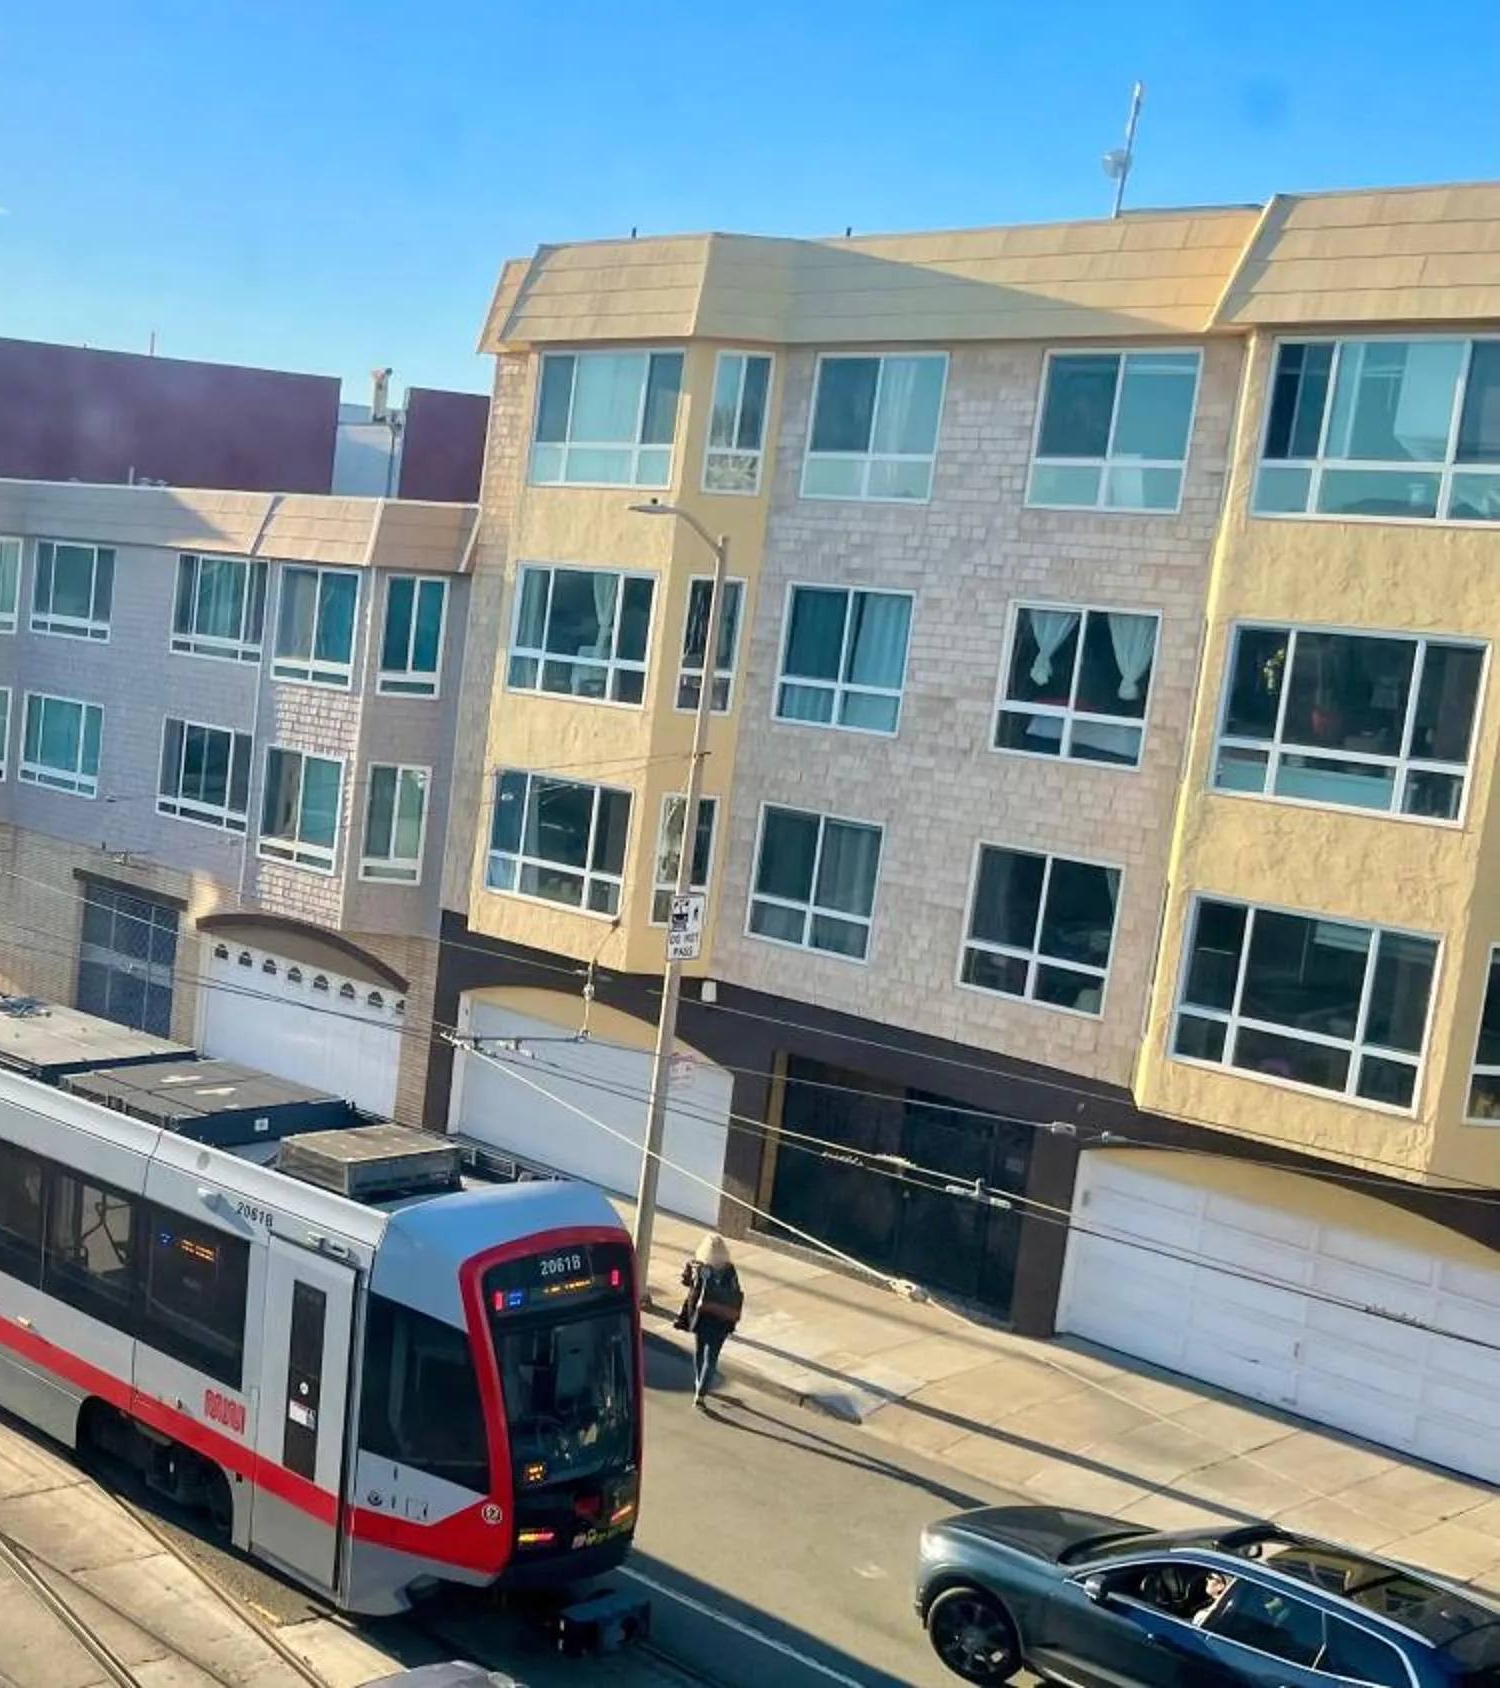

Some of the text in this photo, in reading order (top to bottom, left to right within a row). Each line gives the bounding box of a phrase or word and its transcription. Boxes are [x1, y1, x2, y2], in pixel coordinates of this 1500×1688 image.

[670, 933, 681, 945] DO
[673, 945, 693, 957] PASS
[236, 1201, 274, 1227] 2061B
[539, 1254, 581, 1276] 2061B
